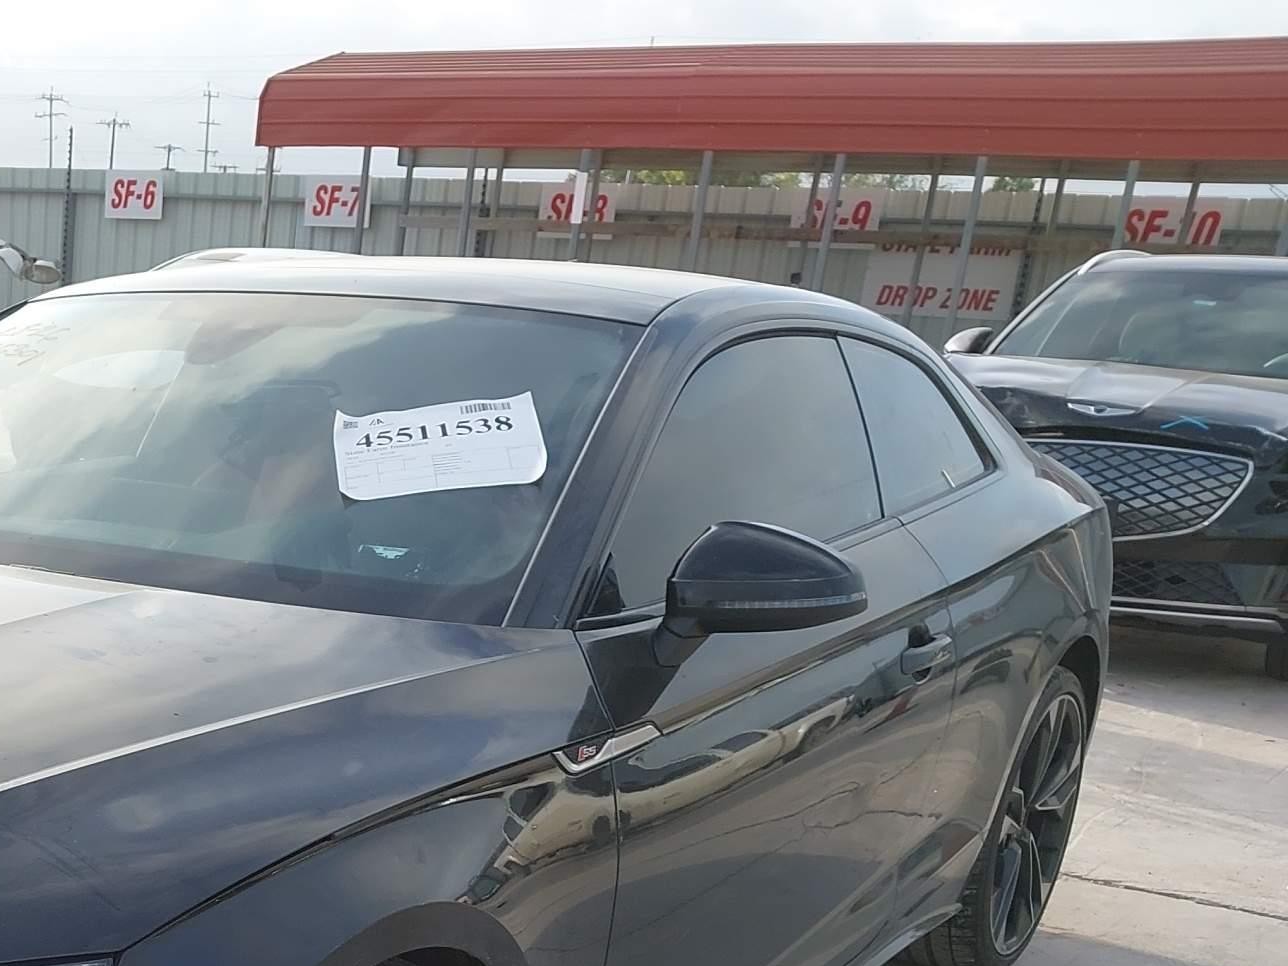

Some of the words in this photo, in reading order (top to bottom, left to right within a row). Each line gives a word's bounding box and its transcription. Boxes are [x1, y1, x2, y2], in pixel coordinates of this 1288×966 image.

[111, 178, 157, 210] SF-6
[312, 184, 361, 217] SF-7
[356, 415, 513, 448] 45511538
